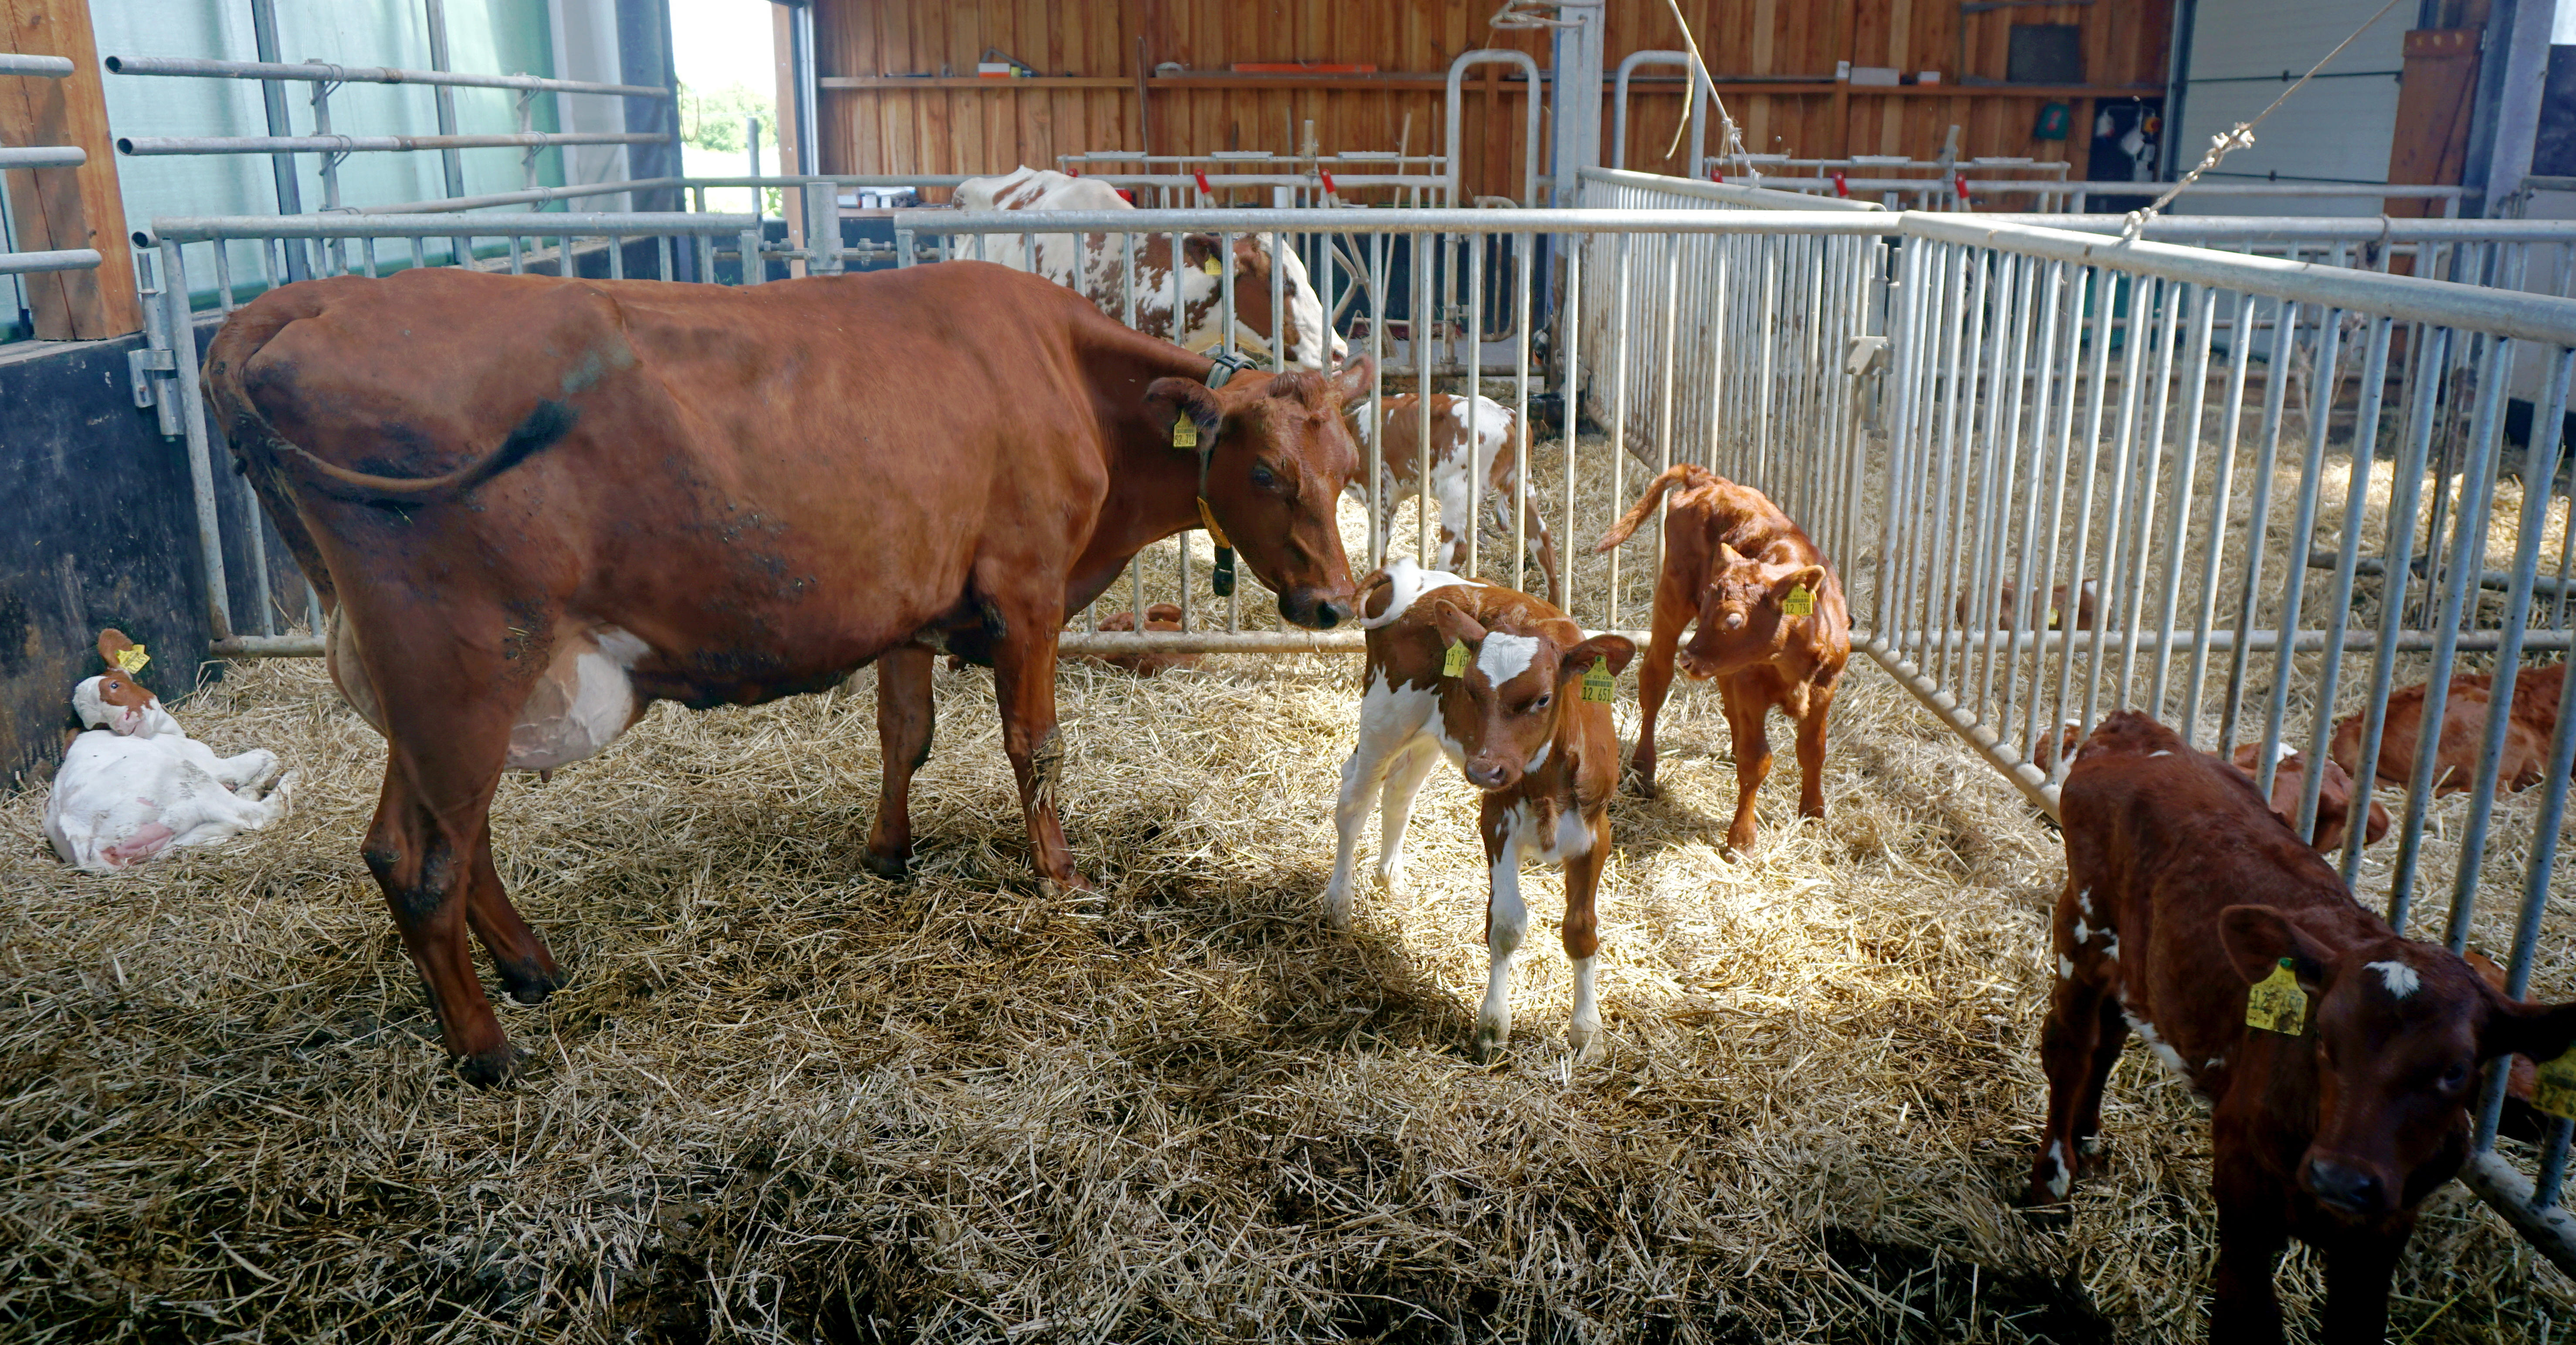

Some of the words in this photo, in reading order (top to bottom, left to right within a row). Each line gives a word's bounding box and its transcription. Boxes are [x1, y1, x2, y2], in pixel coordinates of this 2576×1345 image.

[1786, 604, 1794, 614] 12
[1799, 603, 1810, 613] 730
[1447, 653, 1454, 666] 12
[1582, 687, 1593, 700] 12
[1598, 688, 1610, 702] 651
